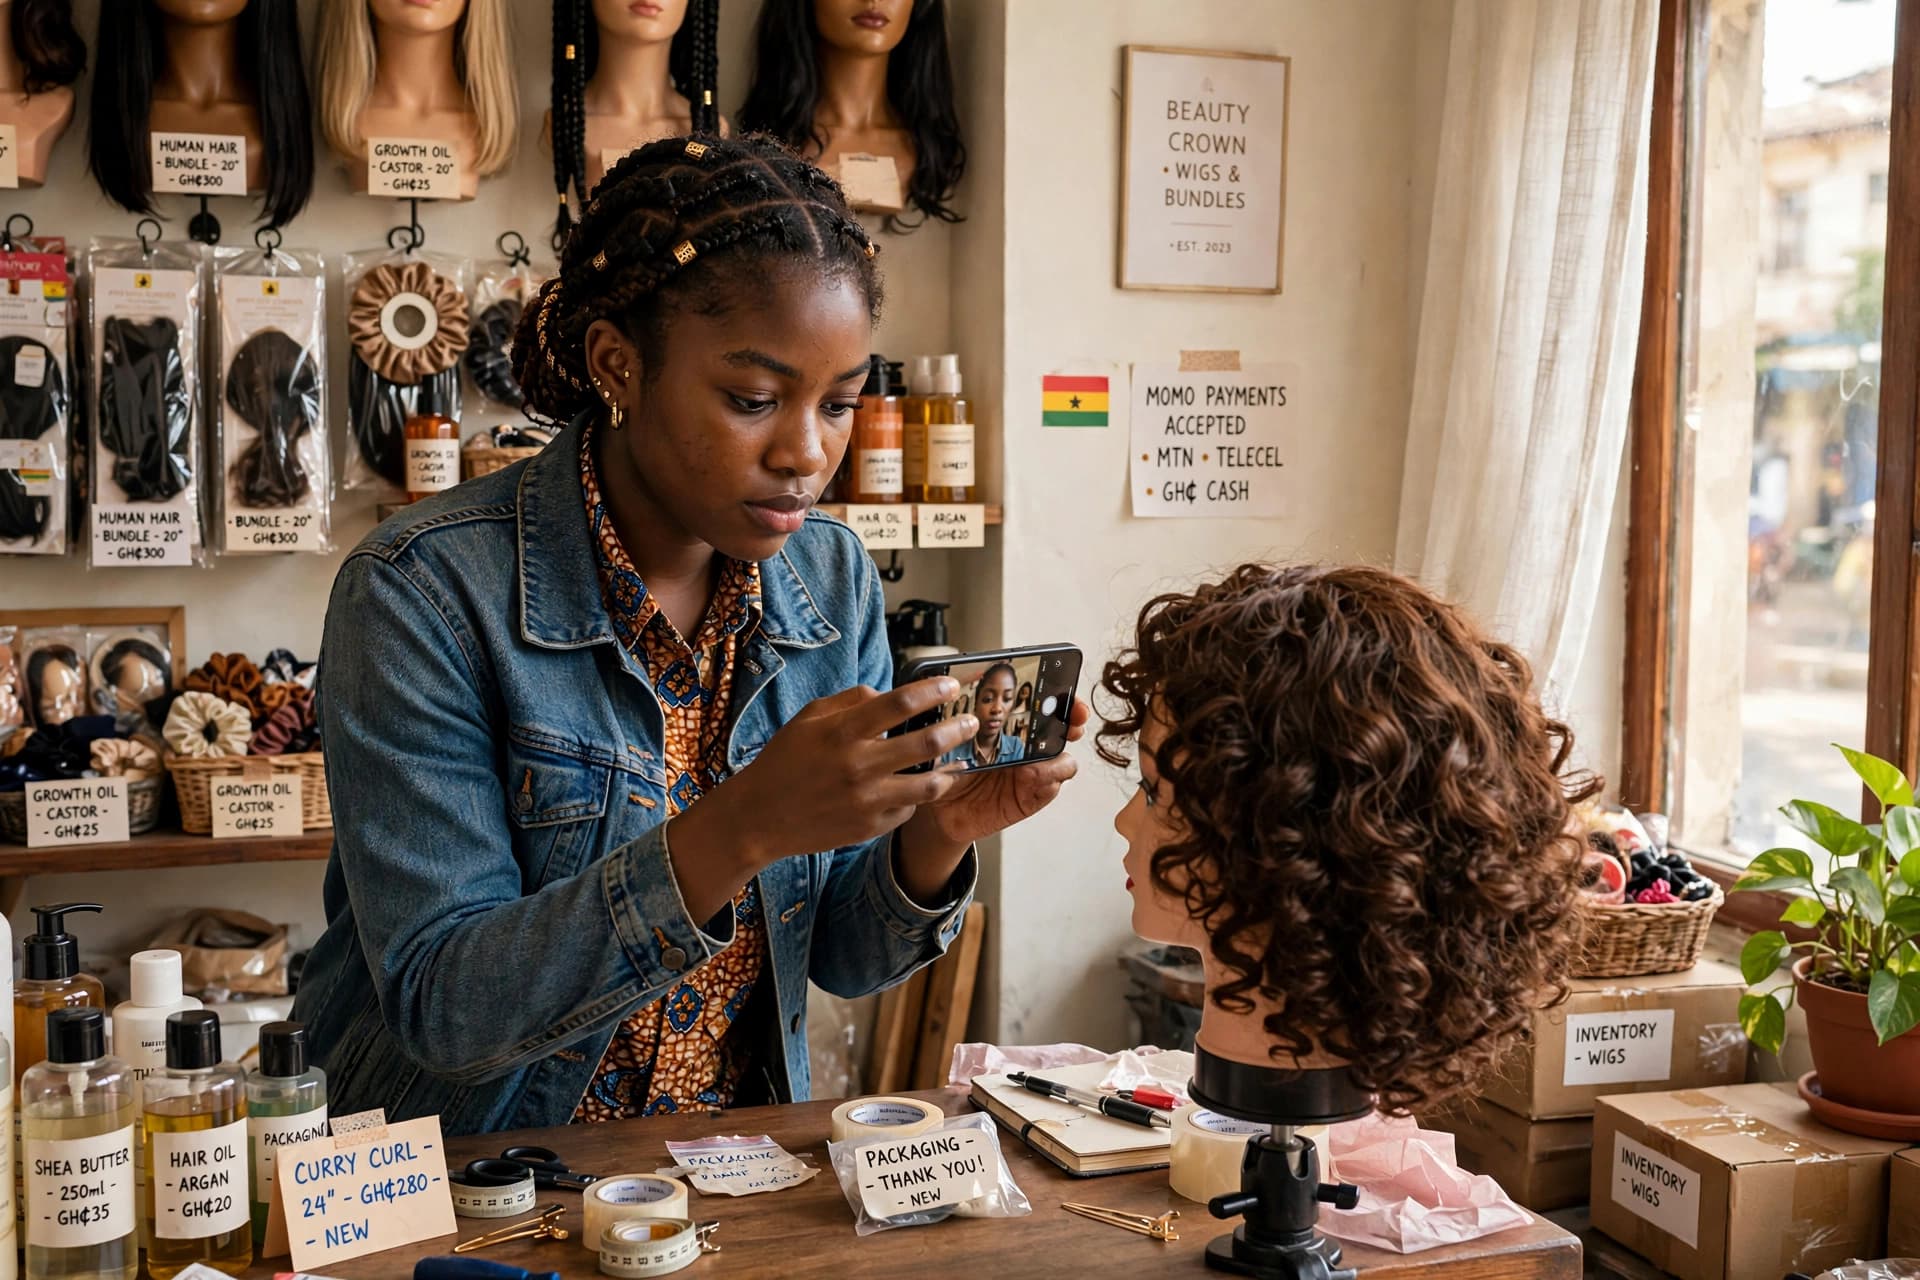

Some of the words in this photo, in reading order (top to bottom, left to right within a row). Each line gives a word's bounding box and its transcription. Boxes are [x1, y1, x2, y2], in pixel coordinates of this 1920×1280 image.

[1167, 100, 1250, 124] BEAUTY
[160, 140, 204, 152] HUMAN
[209, 142, 238, 154] HAIR
[375, 144, 427, 157] GROWTH
[432, 146, 451, 158] OIL
[1168, 132, 1246, 155] CROWN
[165, 157, 209, 170] BUNDLE
[379, 161, 424, 174] CASTOR
[1176, 163, 1221, 182] WIGS
[1228, 165, 1240, 182] &
[1165, 188, 1246, 209] BUNDLES
[1205, 242, 1232, 253] 2023
[1146, 386, 1195, 406] MOMO
[1206, 385, 1287, 407] PAYMENTS
[1165, 415, 1246, 435] ACCEPTED
[1157, 447, 1193, 467] MTN
[1216, 447, 1284, 467] TELECEL
[1207, 480, 1249, 501] CASH
[99, 512, 145, 524] HUMAN
[150, 512, 180, 524] HAIR
[235, 516, 280, 527] BUNDLE
[933, 513, 967, 524] ARGAN
[103, 530, 150, 542] BUNDLE
[33, 787, 91, 802] GROWTH
[97, 786, 118, 799] OIL
[216, 784, 268, 796] GROWTH
[273, 783, 292, 795] OIL
[47, 805, 98, 820] CASTOR
[229, 801, 274, 813] CASTOR
[1576, 1022, 1657, 1043] INVENTORY
[1588, 1048, 1626, 1065] WIGS
[35, 1159, 72, 1176] SHEA
[80, 1147, 129, 1174] BUTTER
[170, 1150, 207, 1168] HAIR
[214, 1144, 236, 1162] OIL
[294, 1152, 356, 1184] CURRY
[369, 1141, 417, 1168] CURL
[866, 1137, 960, 1168] PACKAGING
[179, 1169, 229, 1192] ARGAN
[878, 1166, 937, 1191] THANK
[941, 1154, 985, 1179] YOU!
[1622, 1147, 1687, 1195] INVENTORY
[60, 1180, 104, 1201] 250ml
[910, 1188, 941, 1206] NEW
[1631, 1178, 1660, 1207] WIGS
[302, 1188, 335, 1218] 24"
[325, 1218, 368, 1248] NEW
